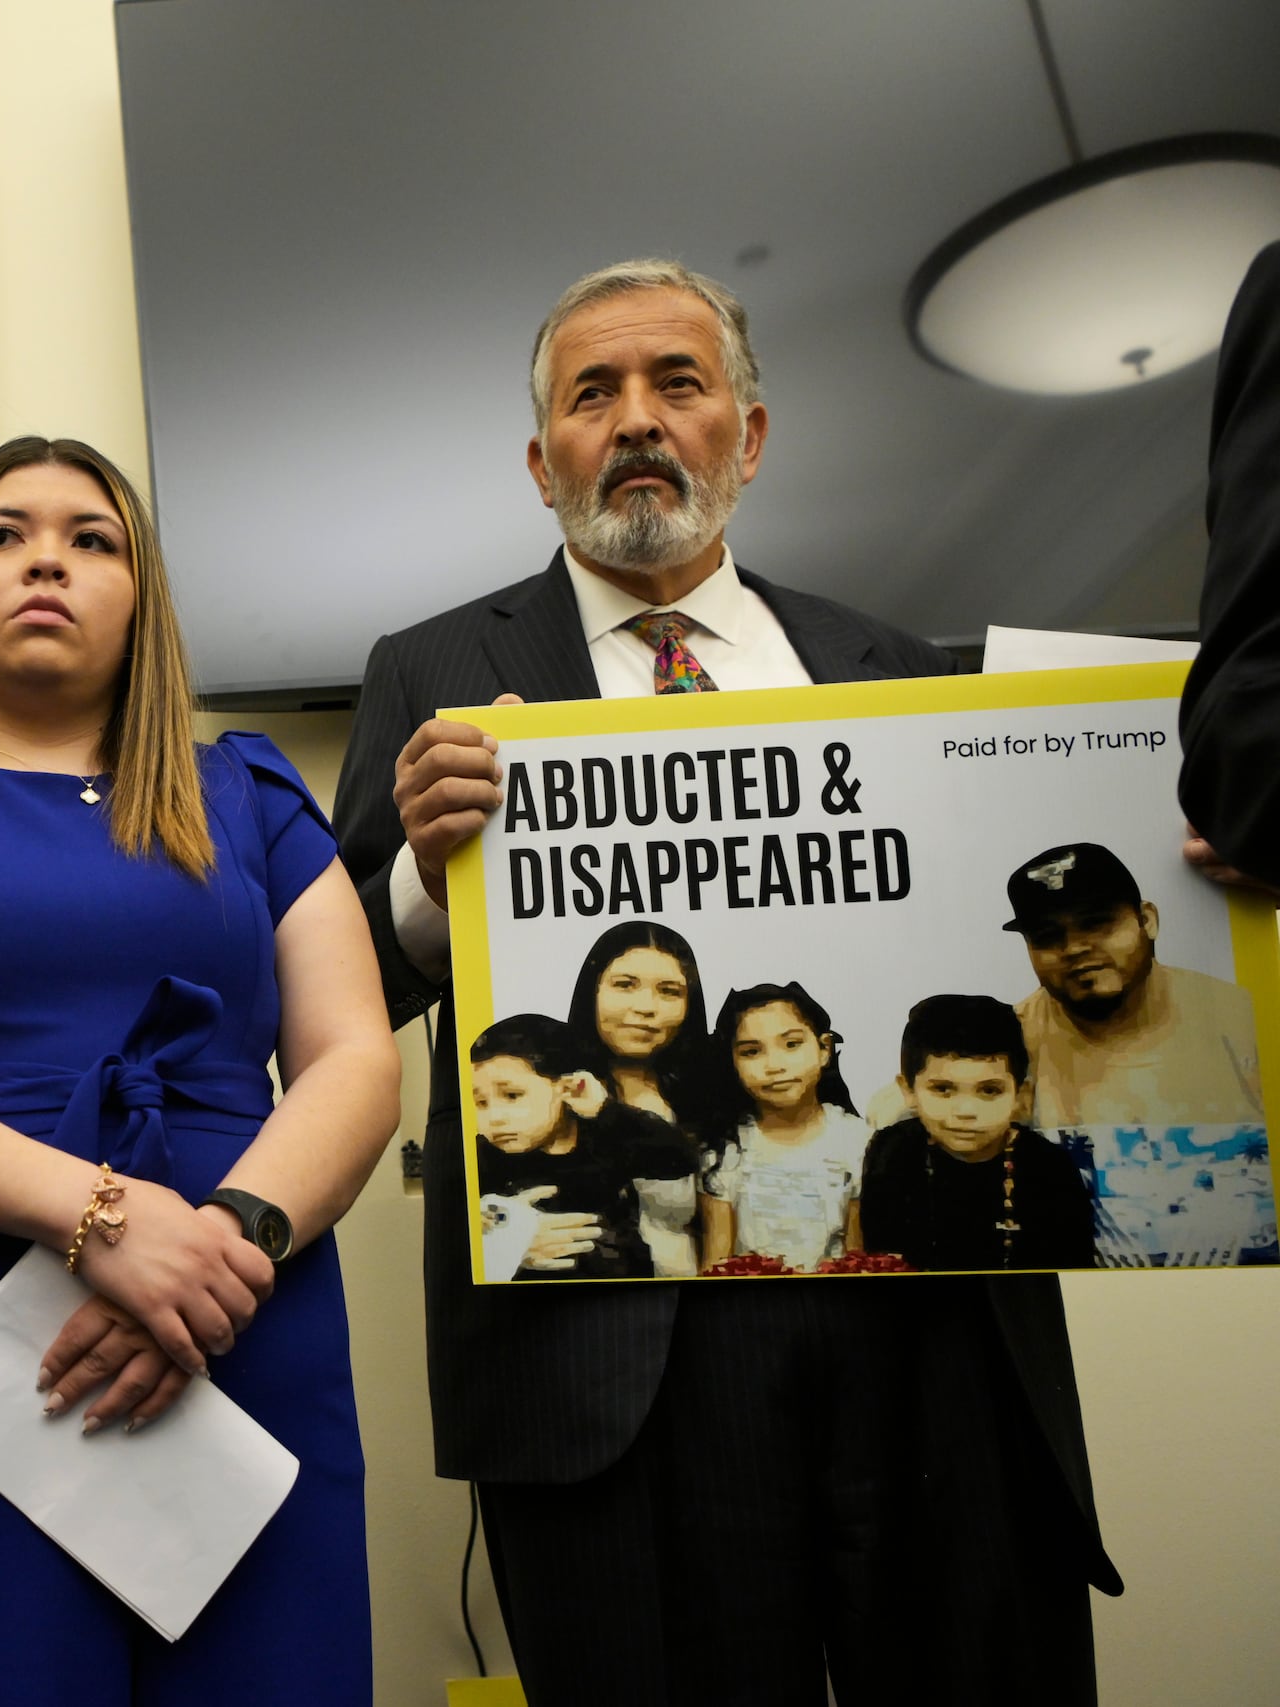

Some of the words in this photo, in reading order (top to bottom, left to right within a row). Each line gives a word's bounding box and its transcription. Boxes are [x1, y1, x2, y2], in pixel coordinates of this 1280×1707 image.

[504, 745, 802, 834] ABDUCTED
[819, 741, 862, 816] &
[942, 736, 997, 759] Paid
[1003, 735, 1038, 755] for
[1044, 733, 1076, 758] by
[1081, 730, 1167, 753] Trump
[508, 827, 912, 920] DISAPPEARED
